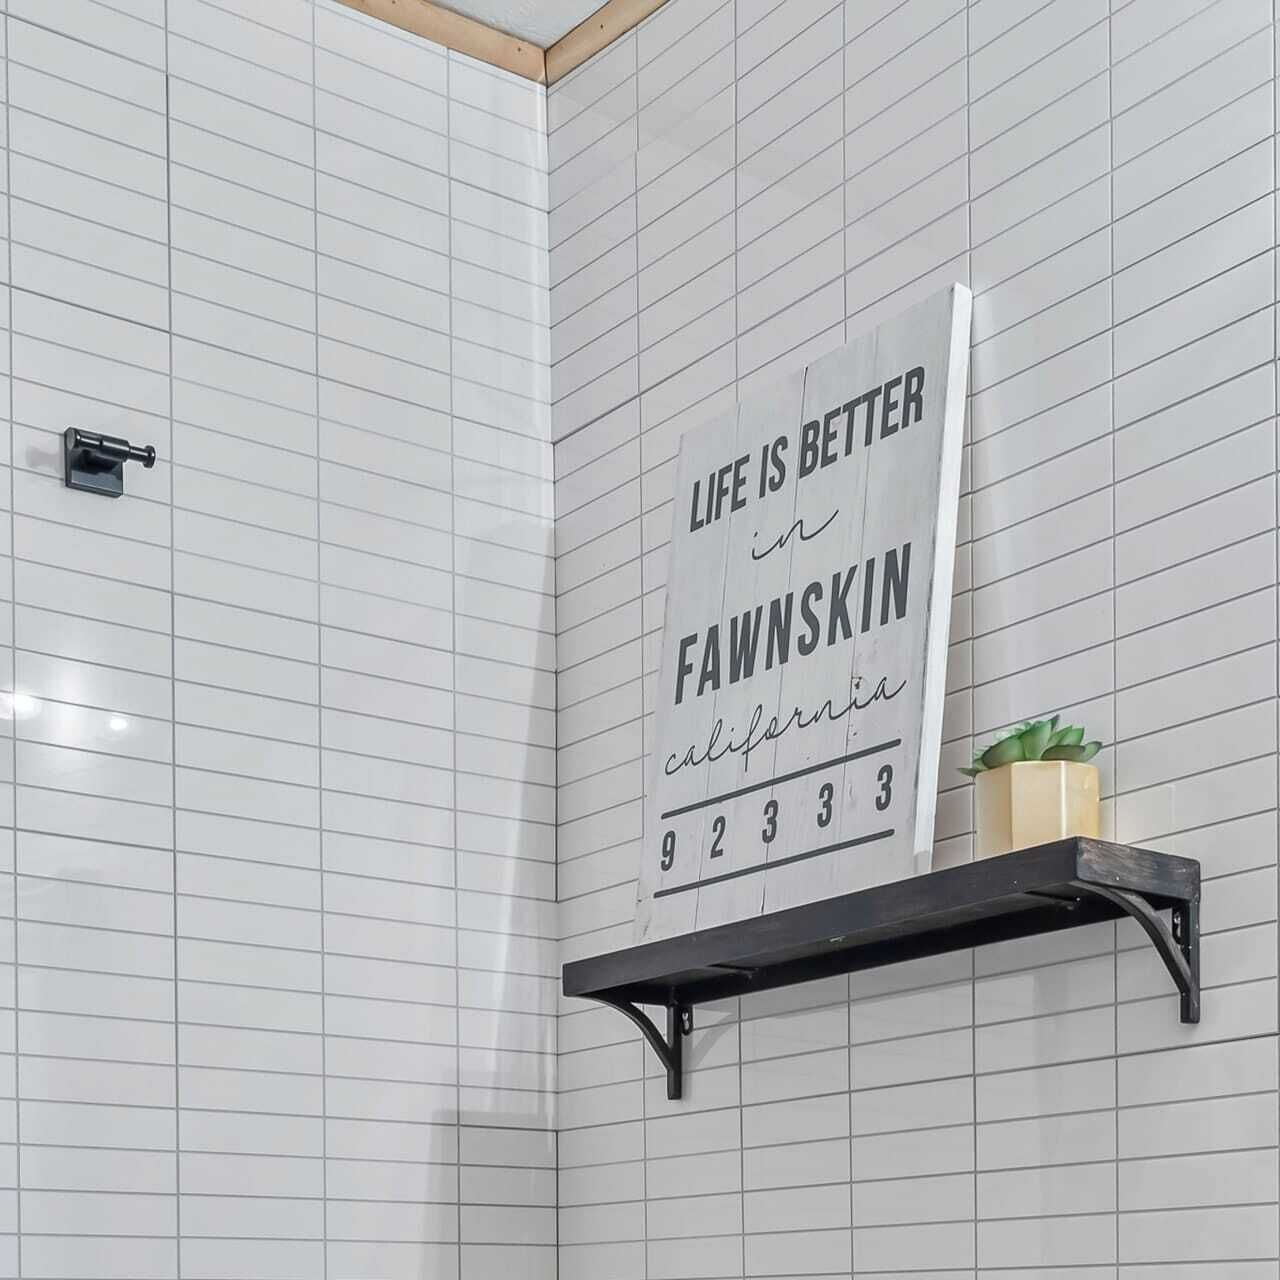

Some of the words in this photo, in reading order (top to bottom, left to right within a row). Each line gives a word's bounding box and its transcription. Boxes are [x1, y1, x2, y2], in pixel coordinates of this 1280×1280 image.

[689, 453, 751, 533] LIFE
[758, 435, 788, 499] IS
[798, 366, 926, 479] BETTER
[750, 509, 840, 562] in
[674, 542, 912, 705] FAWNSKIN
[664, 676, 907, 773] california
